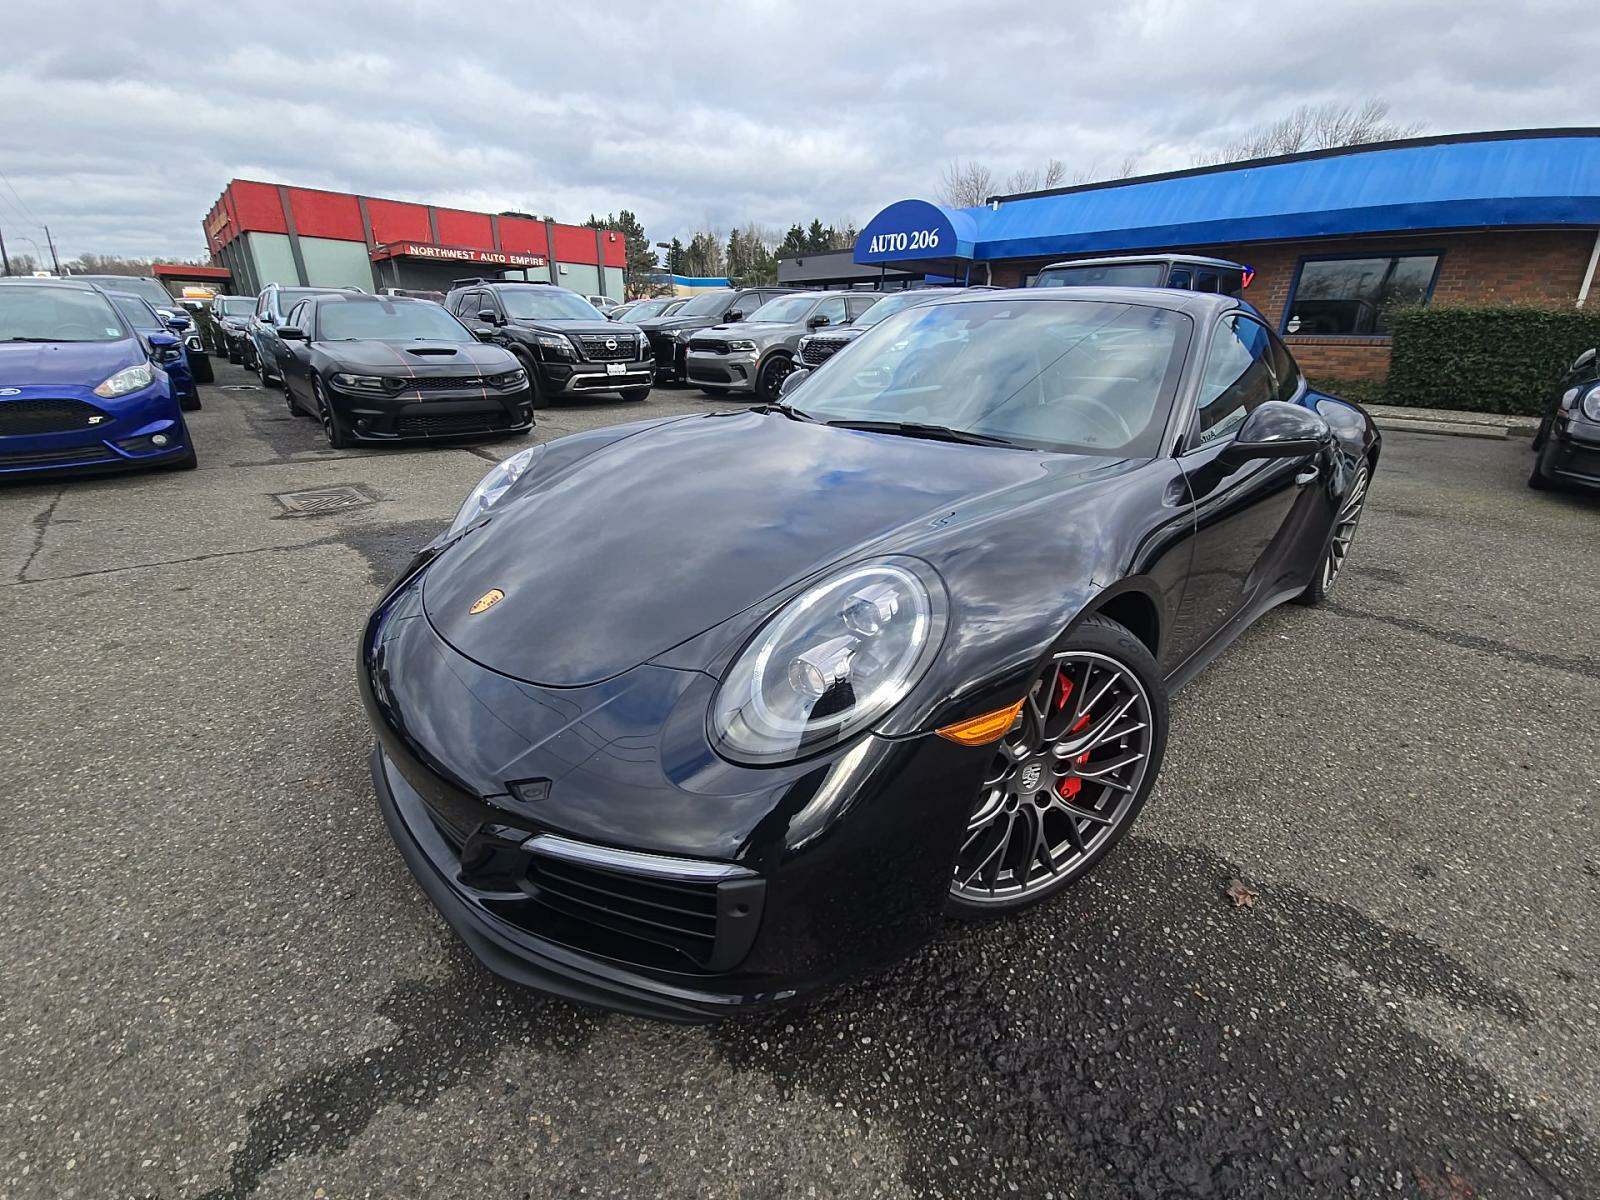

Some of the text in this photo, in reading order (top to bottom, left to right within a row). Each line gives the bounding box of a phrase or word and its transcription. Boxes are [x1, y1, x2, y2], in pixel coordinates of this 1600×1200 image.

[868, 227, 939, 253] AUTO 206
[409, 245, 545, 266] NORTHWEST AUTO EMPIRE
[88, 416, 103, 424] ST
